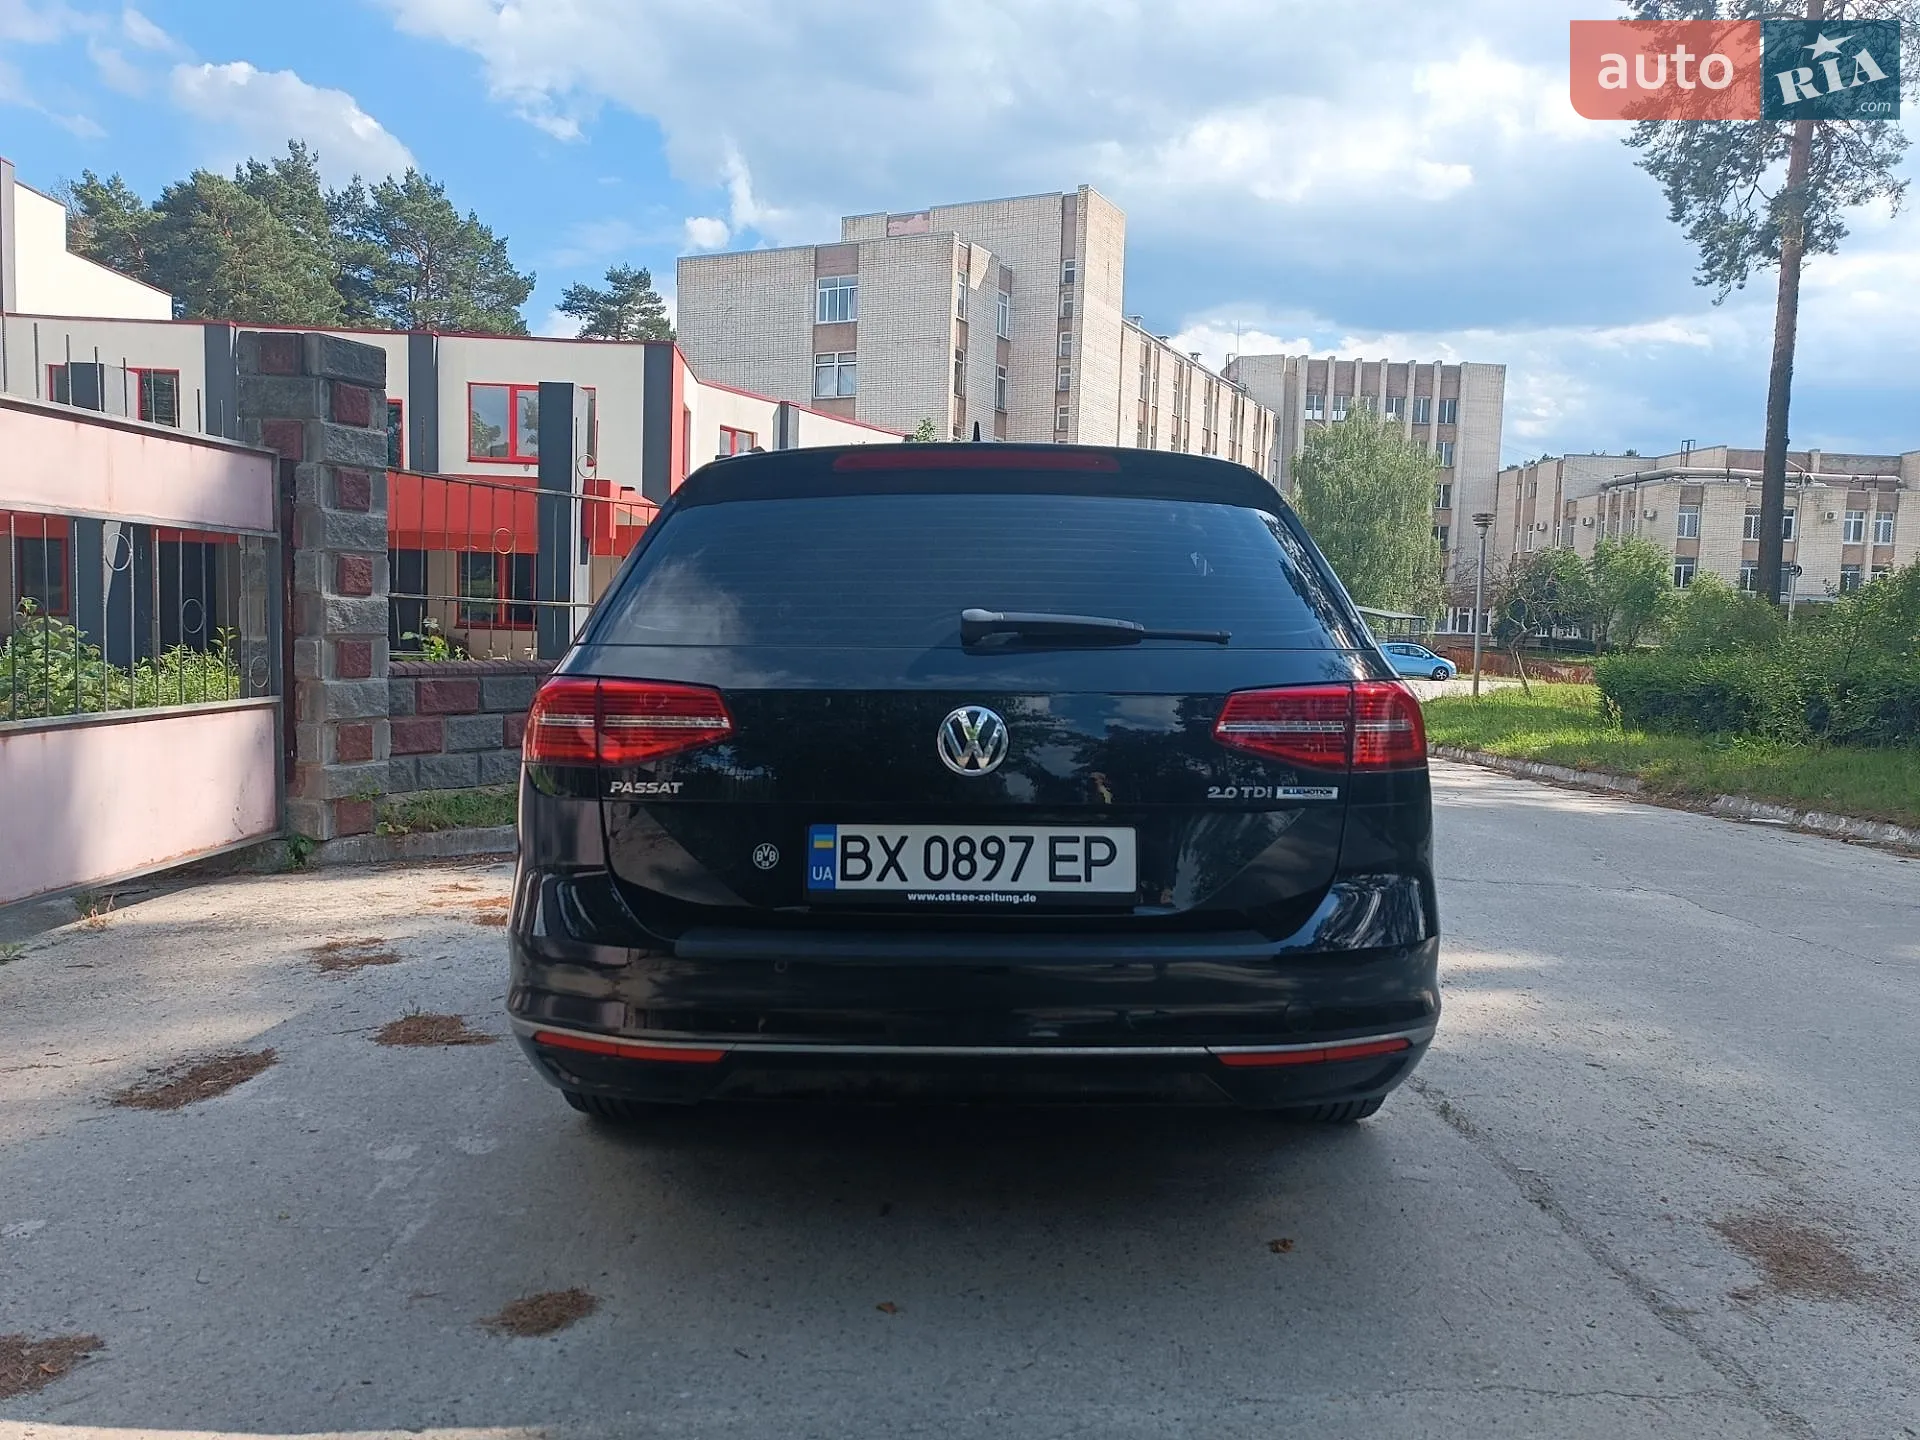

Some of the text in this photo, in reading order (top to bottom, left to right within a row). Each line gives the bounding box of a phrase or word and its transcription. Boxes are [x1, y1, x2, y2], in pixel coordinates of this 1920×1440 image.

[610, 781, 684, 794] PASSAT
[1240, 785, 1273, 799] TDI
[840, 835, 1117, 883] BX 0897 EP
[812, 866, 833, 881] UA
[907, 892, 1037, 904] www.ostsee-zeitung.de
